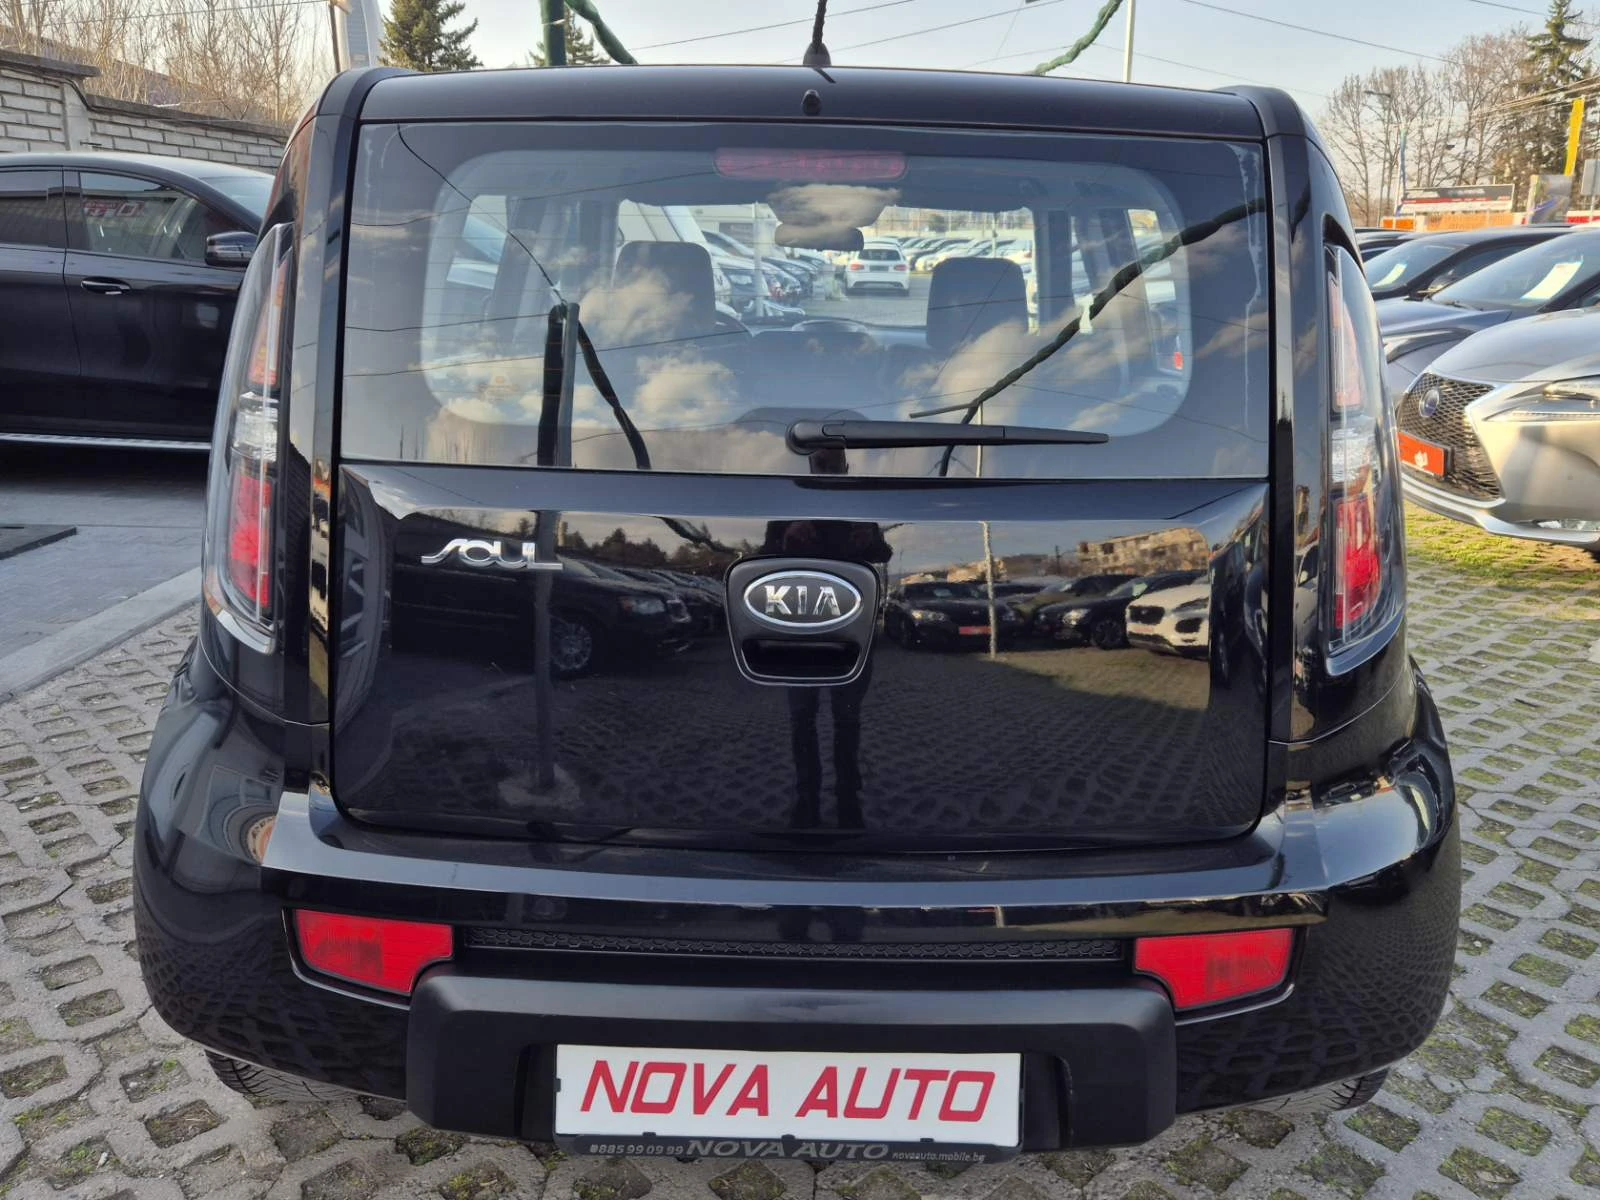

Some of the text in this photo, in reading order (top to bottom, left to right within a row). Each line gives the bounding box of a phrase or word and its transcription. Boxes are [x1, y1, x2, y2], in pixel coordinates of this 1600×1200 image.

[421, 538, 563, 570] SOUL
[764, 585, 841, 615] KIA
[580, 1059, 996, 1122] NOVA AUTO
[626, 1144, 644, 1155] 99
[648, 1145, 664, 1155] 09
[666, 1145, 684, 1155] 99
[686, 1140, 786, 1157] NOVA
[791, 1142, 889, 1159] AUTO
